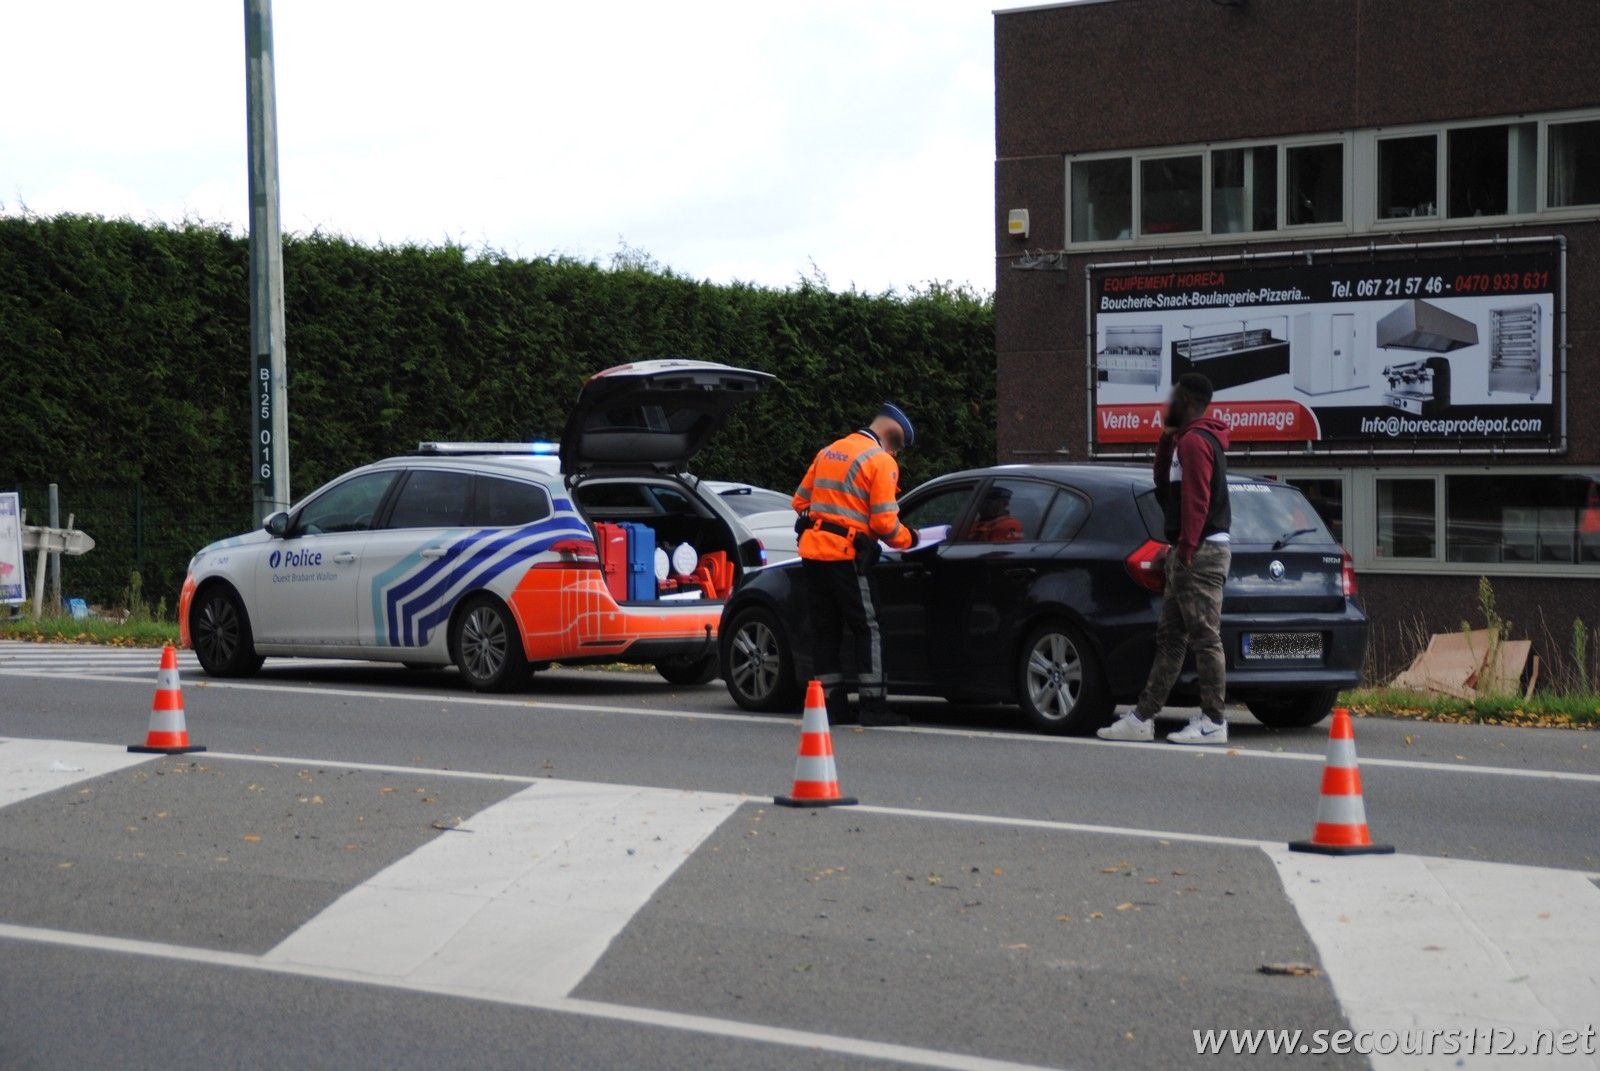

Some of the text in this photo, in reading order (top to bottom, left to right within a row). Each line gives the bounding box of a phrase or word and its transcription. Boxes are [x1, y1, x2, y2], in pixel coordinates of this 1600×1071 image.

[1104, 271, 1226, 292] EQUIPEMENT HORECA
[1331, 281, 1353, 297] Tel.
[1357, 279, 1382, 296] 067
[1385, 278, 1400, 295] 21
[1405, 277, 1422, 294] 57
[1425, 276, 1443, 293] 46
[1455, 274, 1488, 292] 0470
[1493, 273, 1519, 290] 933
[1523, 271, 1549, 289] 631
[260, 368, 271, 478] B125 016
[1102, 411, 1140, 429] Vente
[1213, 408, 1294, 431] Dépannage
[1361, 416, 1542, 437] Info@horecaprodepot.com
[825, 450, 849, 462] Police
[285, 549, 322, 567] Police
